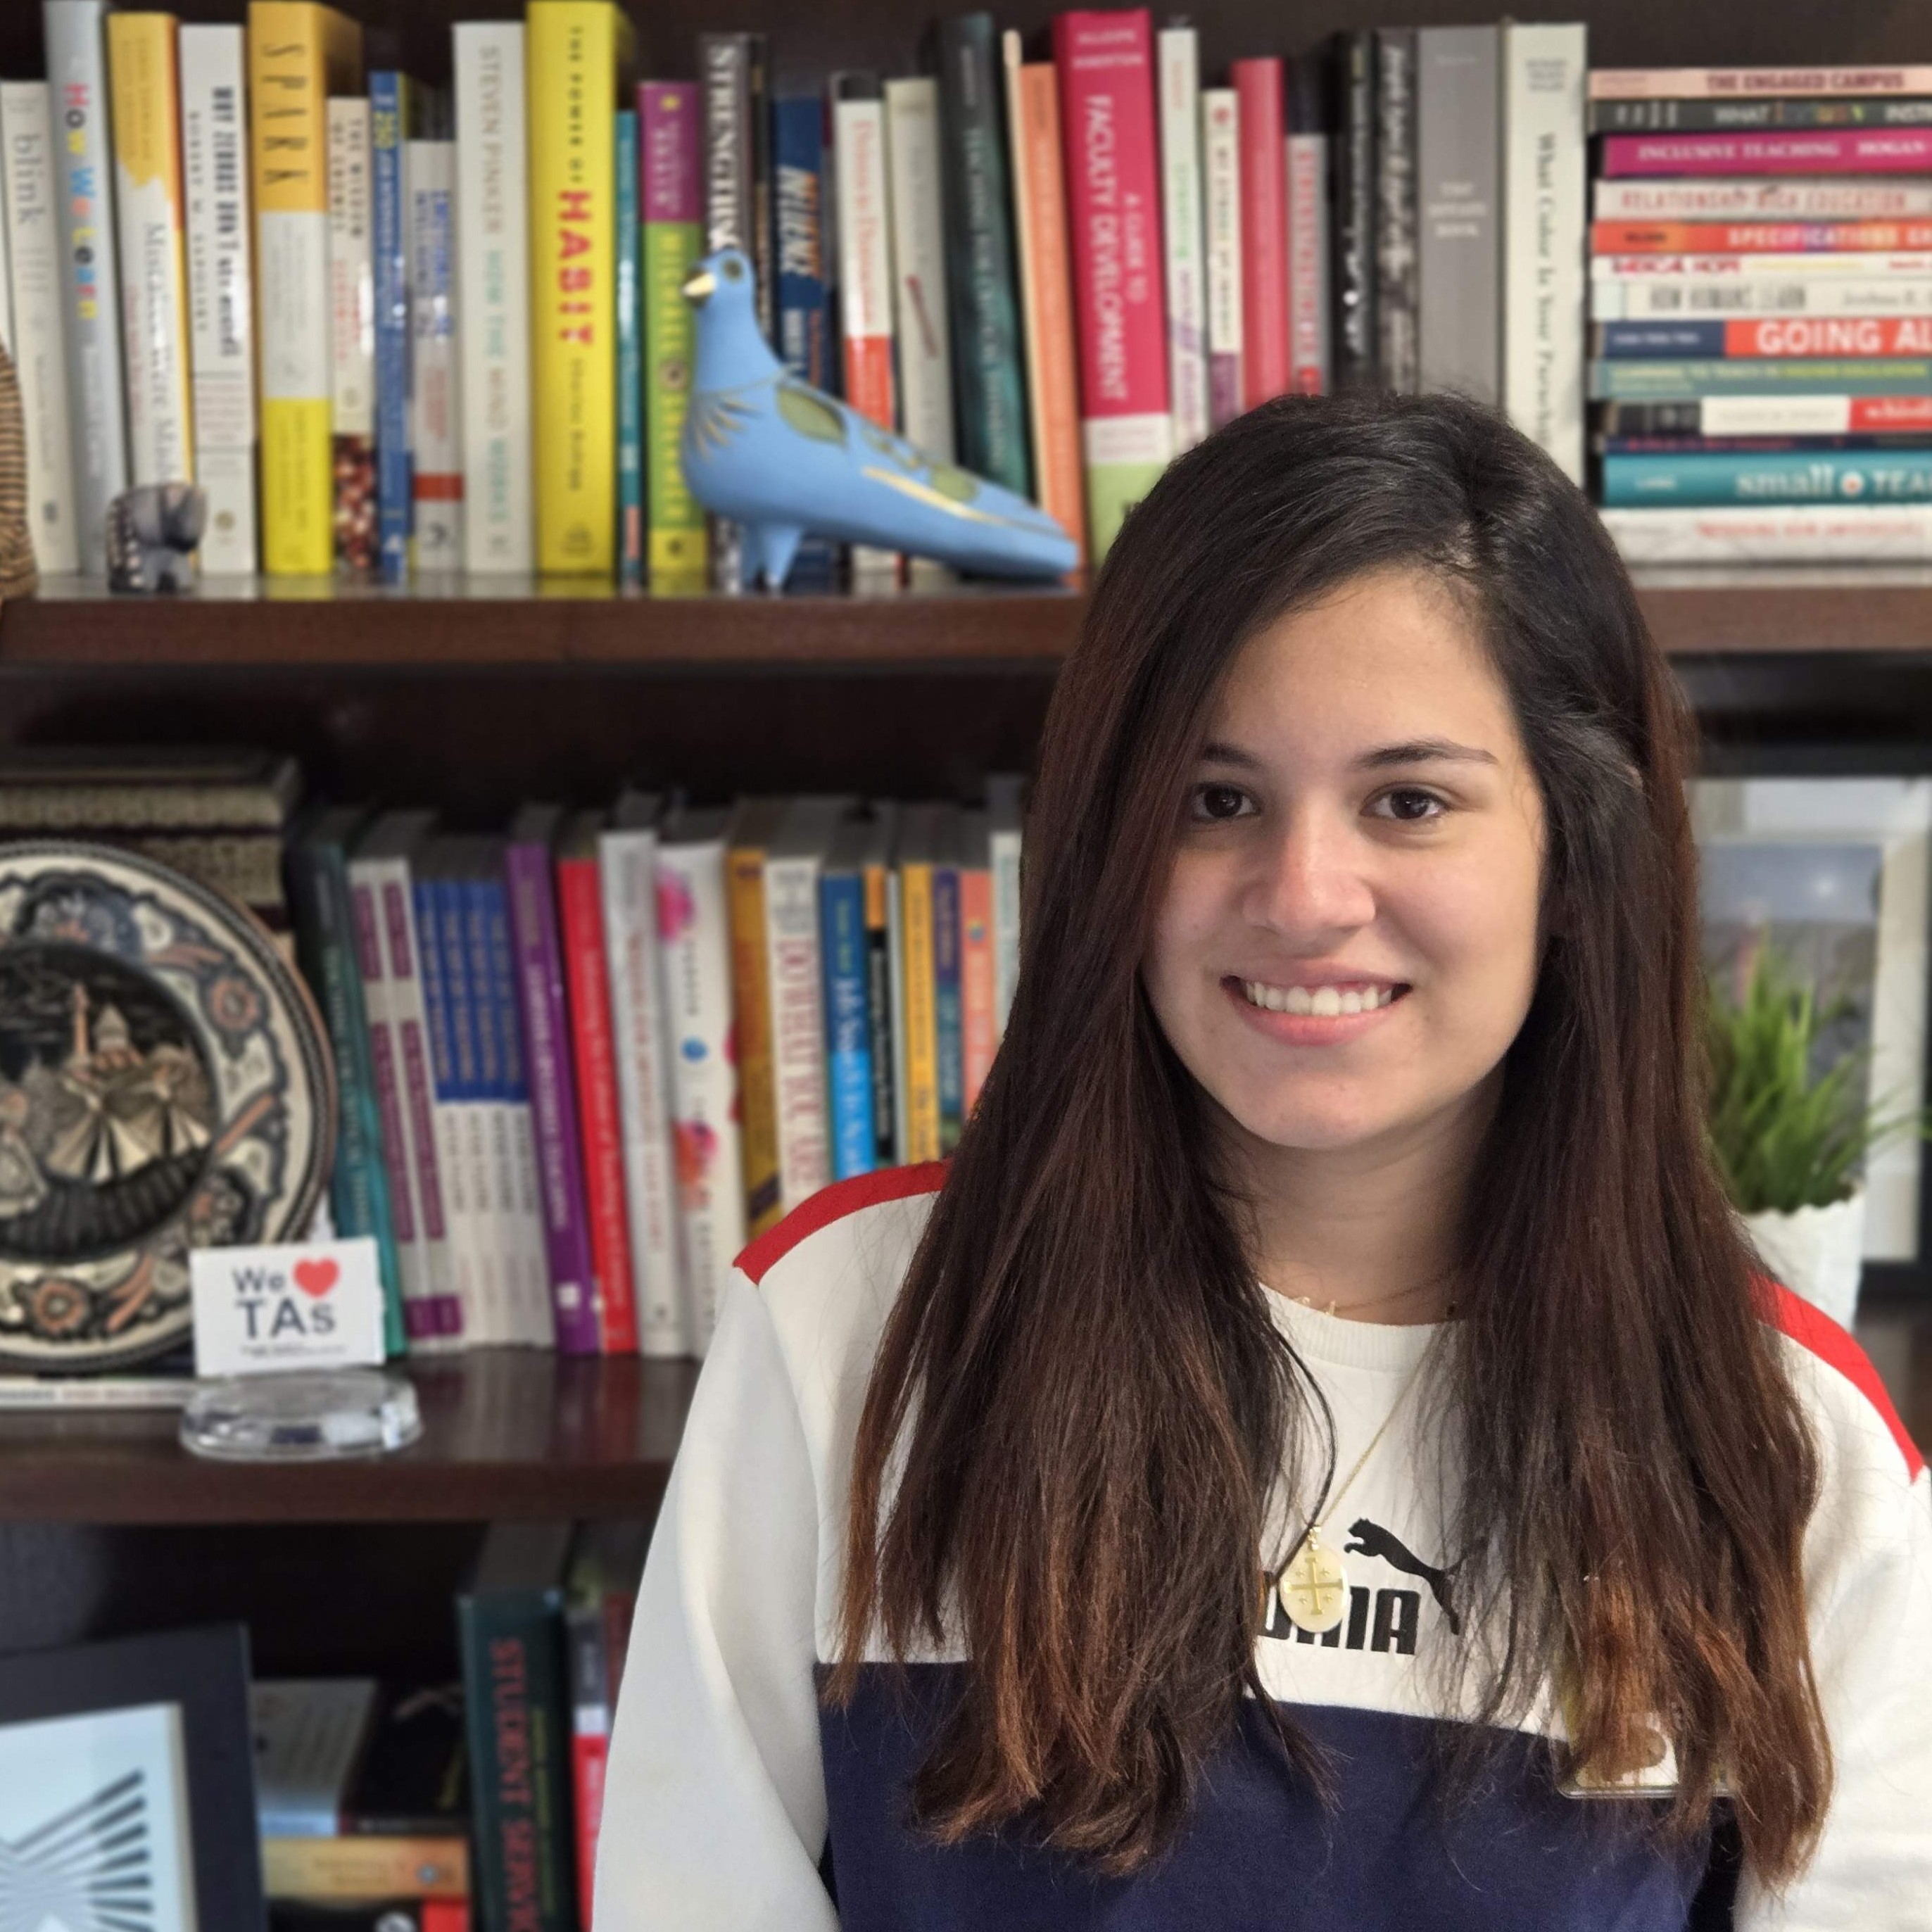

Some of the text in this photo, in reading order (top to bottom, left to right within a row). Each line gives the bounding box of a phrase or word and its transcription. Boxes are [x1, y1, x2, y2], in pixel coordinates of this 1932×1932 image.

[260, 42, 310, 185] SPARK
[479, 46, 503, 136] STEVEN
[1705, 71, 1905, 90] THE ENGAGED CAMPUS
[65, 82, 90, 155] How
[1087, 95, 1118, 206] FACULTY
[1638, 142, 1736, 161] INCLUSIVE
[1742, 141, 1841, 160] TEACHING
[13, 134, 47, 227] blink
[70, 166, 97, 217] We
[481, 141, 505, 234] PINKER
[1537, 132, 1555, 189] What
[1537, 195, 1555, 259] Color
[72, 226, 98, 320] Learn
[558, 190, 593, 345] HABIT
[1090, 213, 1128, 400] DEVELOPMENT
[1538, 293, 1555, 342] Your
[1755, 320, 1882, 353] GOING
[1734, 462, 1835, 497] small
[232, 1265, 286, 1294] We
[490, 1636, 531, 1802] STUDENT
